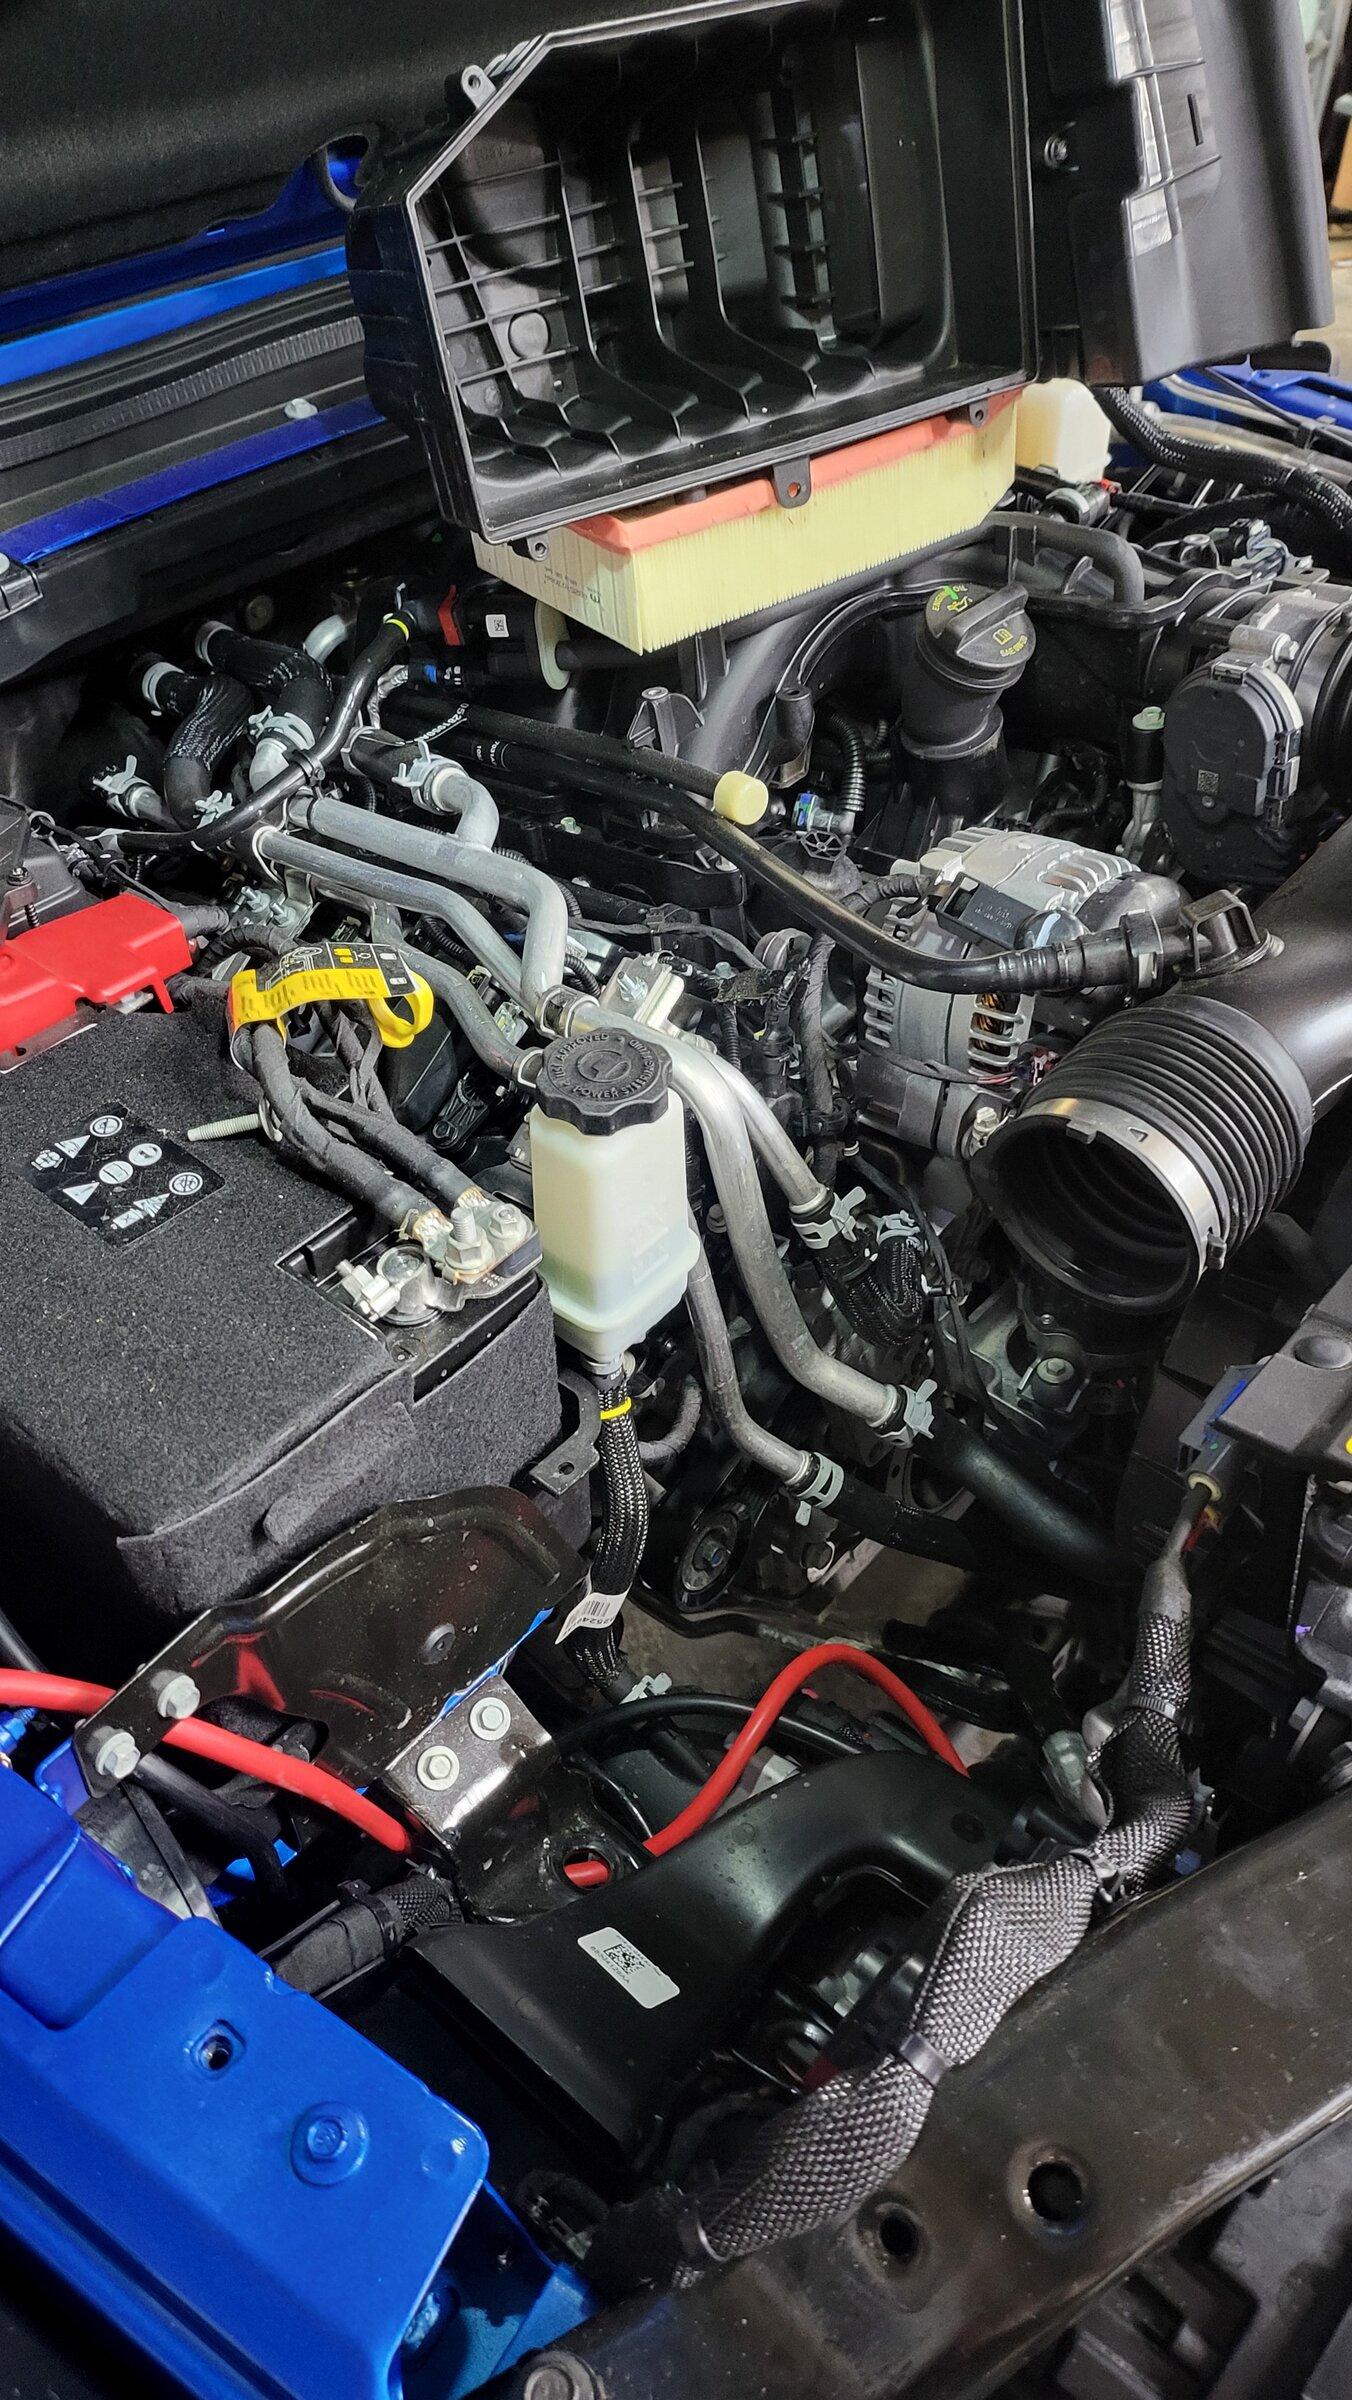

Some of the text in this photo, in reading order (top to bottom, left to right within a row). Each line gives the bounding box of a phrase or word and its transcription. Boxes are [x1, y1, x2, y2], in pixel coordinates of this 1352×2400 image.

[953, 584, 968, 593] OIL
[554, 1032, 610, 1062] APPROVED
[571, 1085, 619, 1099] POWER
[620, 1060, 656, 1097] STEERING
